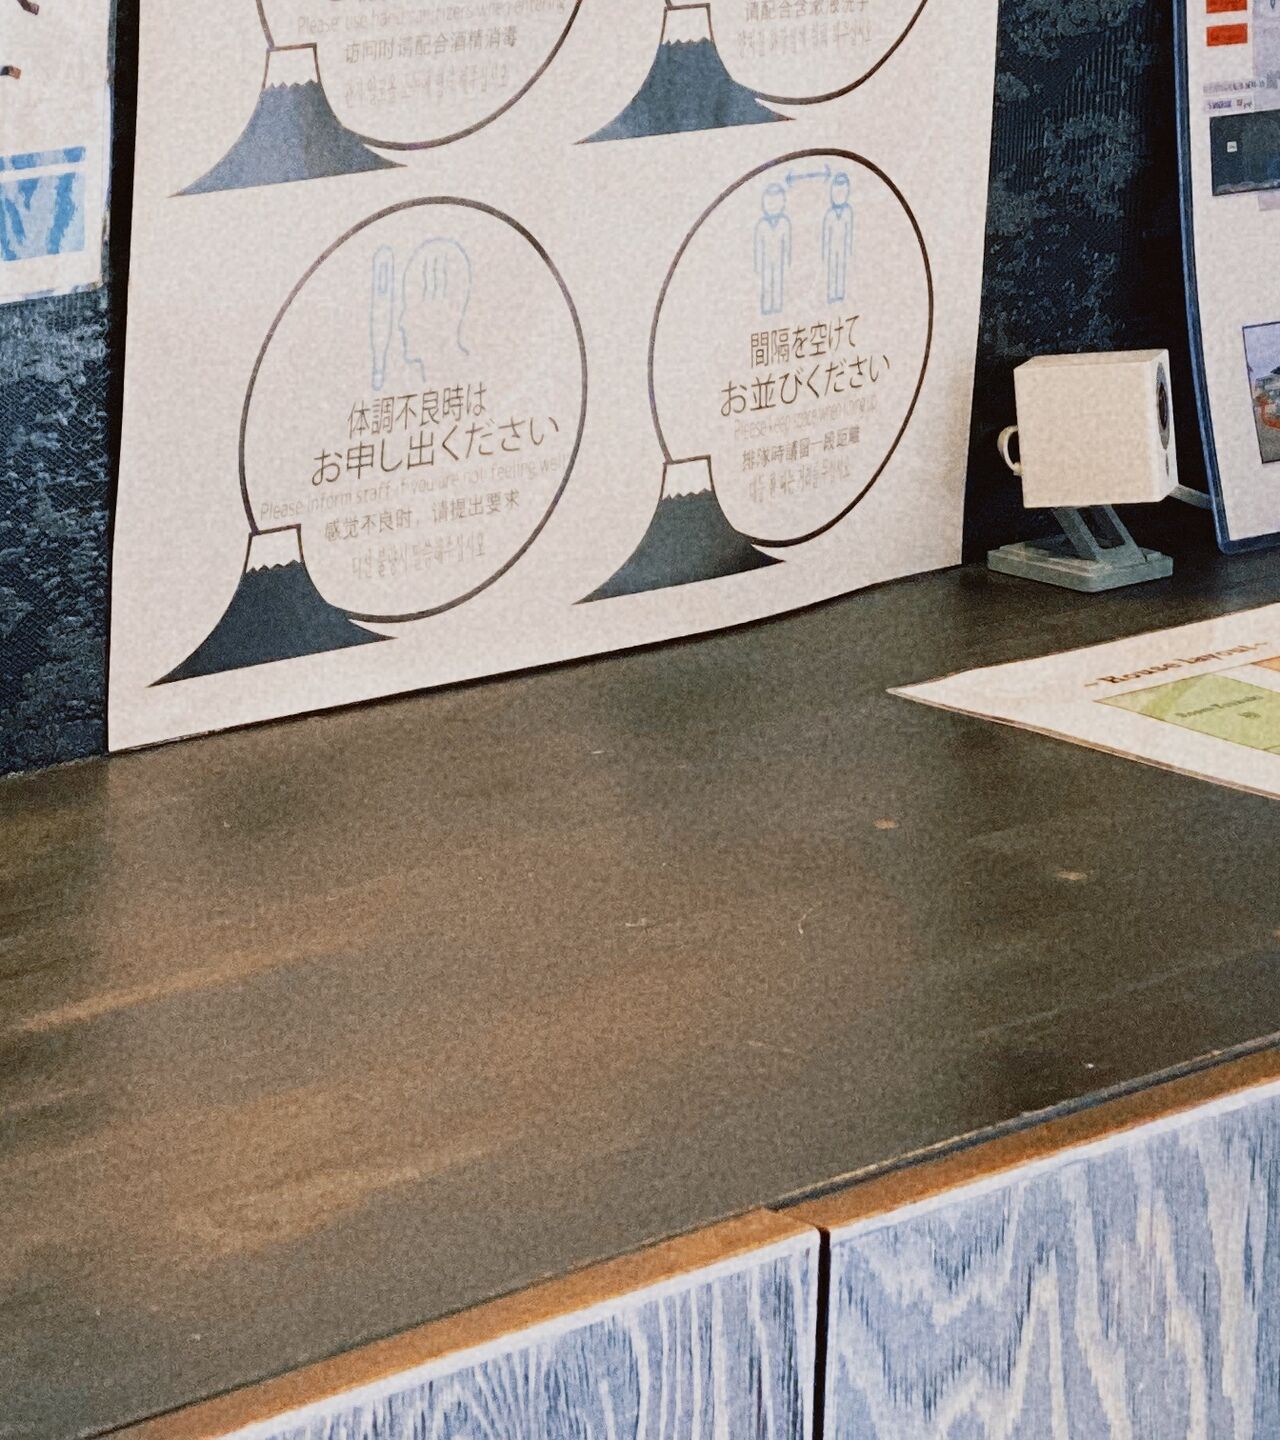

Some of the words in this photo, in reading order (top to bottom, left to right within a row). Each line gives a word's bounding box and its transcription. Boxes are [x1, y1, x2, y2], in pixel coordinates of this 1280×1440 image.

[297, 15, 340, 35] Please
[749, 314, 860, 369] 間隔を空けて
[347, 381, 488, 440] 体調不良時は
[720, 353, 890, 417] お並びください
[311, 415, 561, 487] お申し出ください
[260, 499, 304, 521] Please
[306, 490, 352, 511] inform
[356, 481, 392, 504] staff
[411, 479, 434, 496] you
